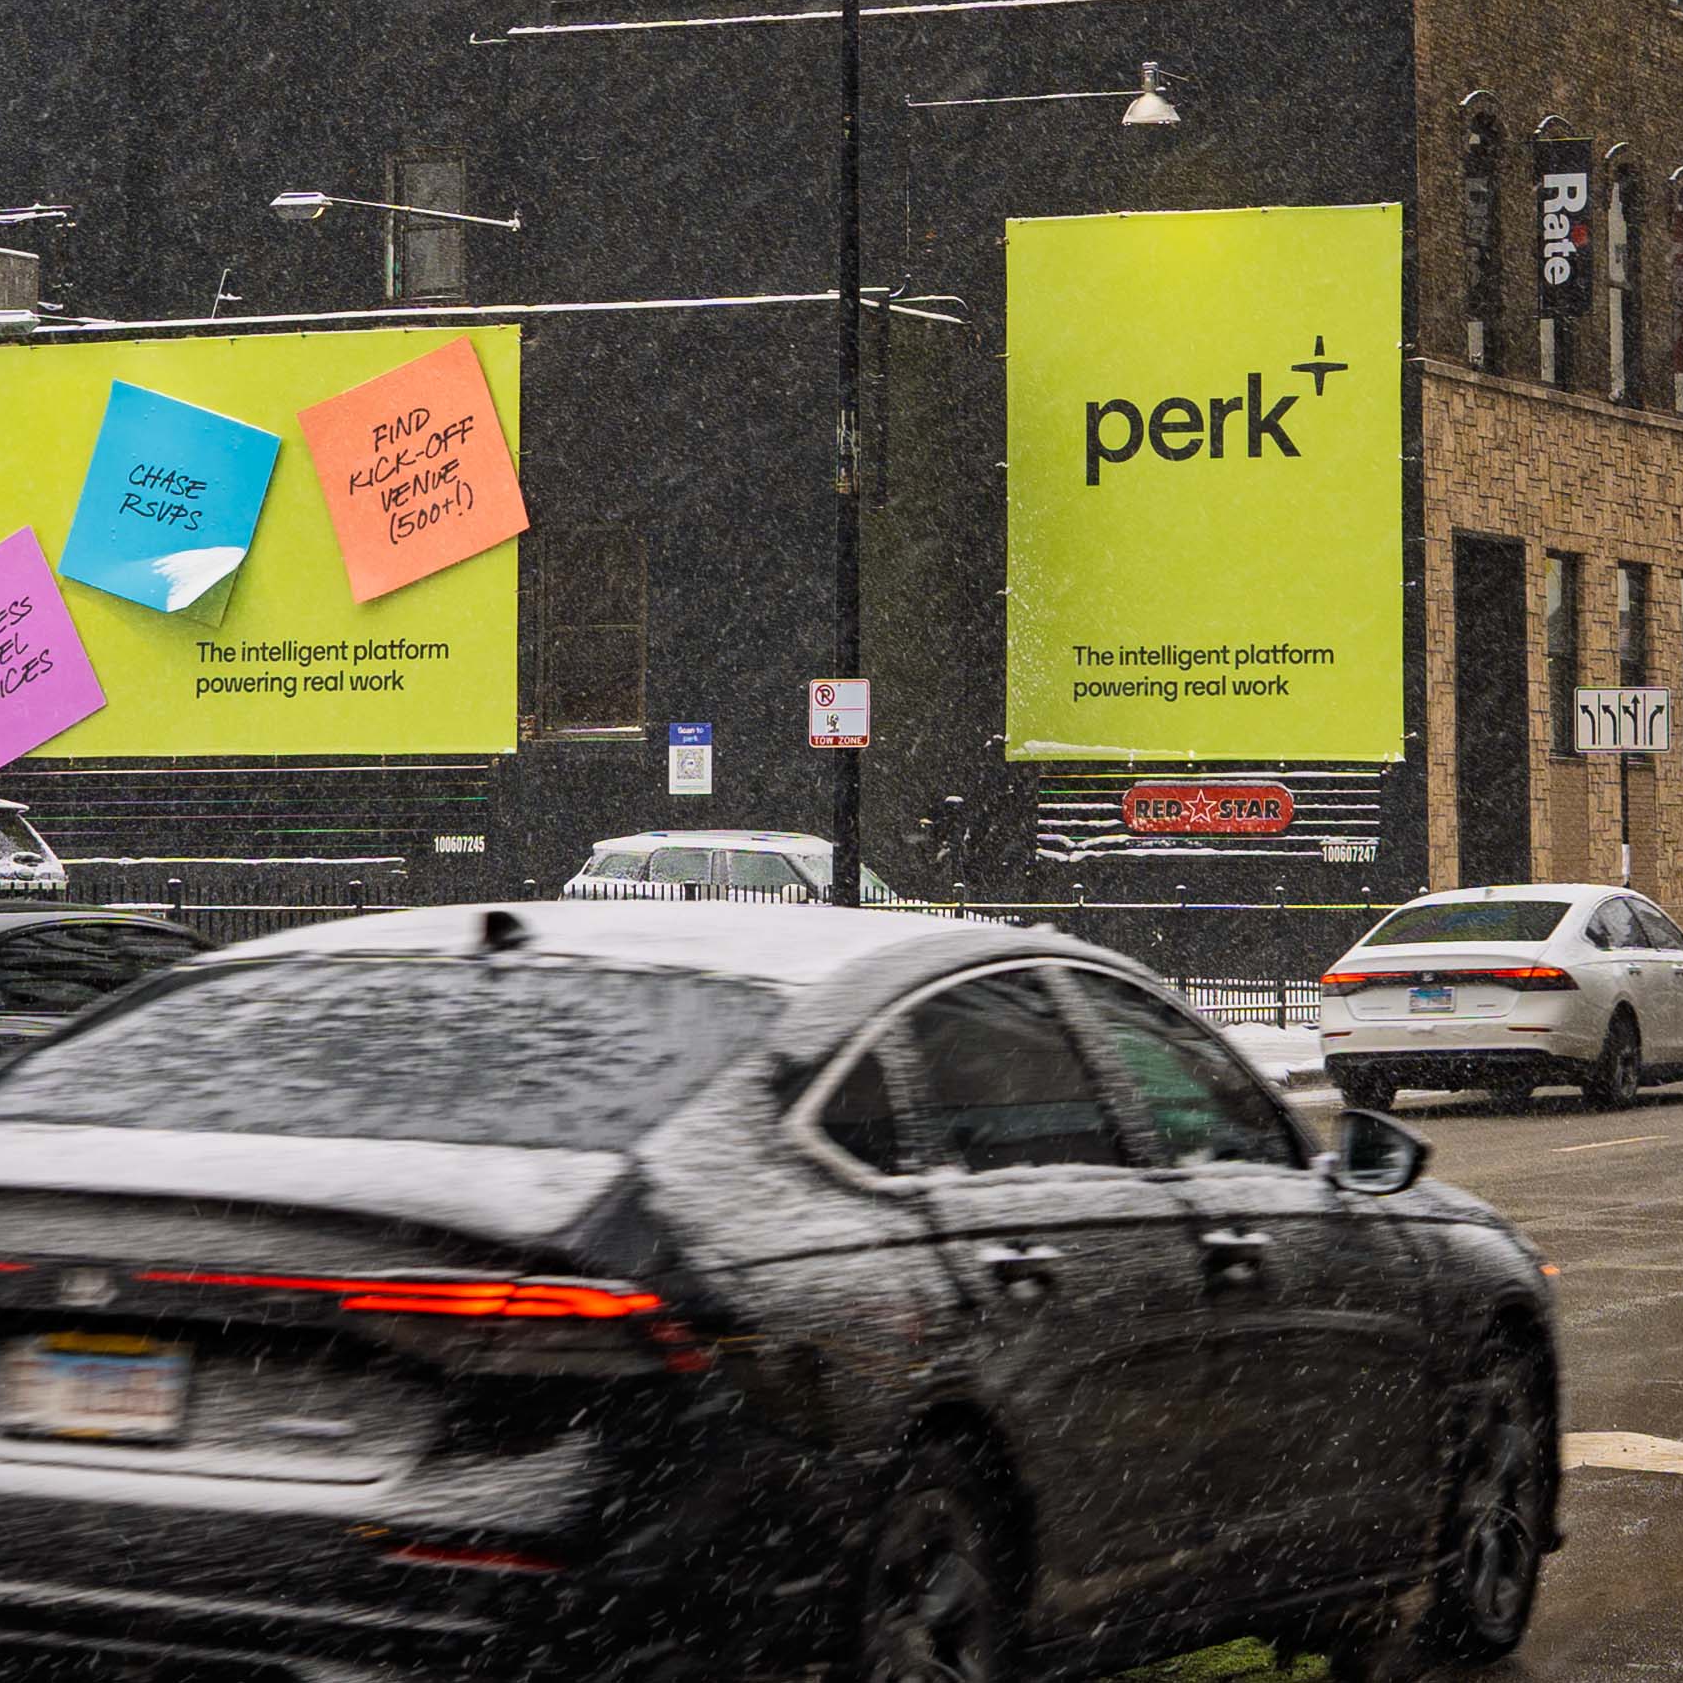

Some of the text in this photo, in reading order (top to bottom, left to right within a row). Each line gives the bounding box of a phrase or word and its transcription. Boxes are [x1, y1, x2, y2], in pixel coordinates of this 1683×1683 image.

[1543, 172, 1588, 286] Rate
[372, 408, 431, 453] FIND
[1086, 372, 1302, 486] perk
[349, 416, 475, 495] KICK-OFF
[128, 463, 207, 499] CHASE
[380, 459, 461, 513] VENUE
[120, 493, 204, 532] RSVPS
[196, 638, 449, 667] The intelligent platform
[1072, 643, 1334, 671] The intelligent platform
[196, 669, 404, 699] powering real work
[1073, 674, 1289, 702] powering real work
[814, 736, 863, 745] TOW ZONE
[1134, 798, 1283, 821] RED STAR
[434, 835, 486, 853] 100607245
[1322, 844, 1378, 863] 100607247
